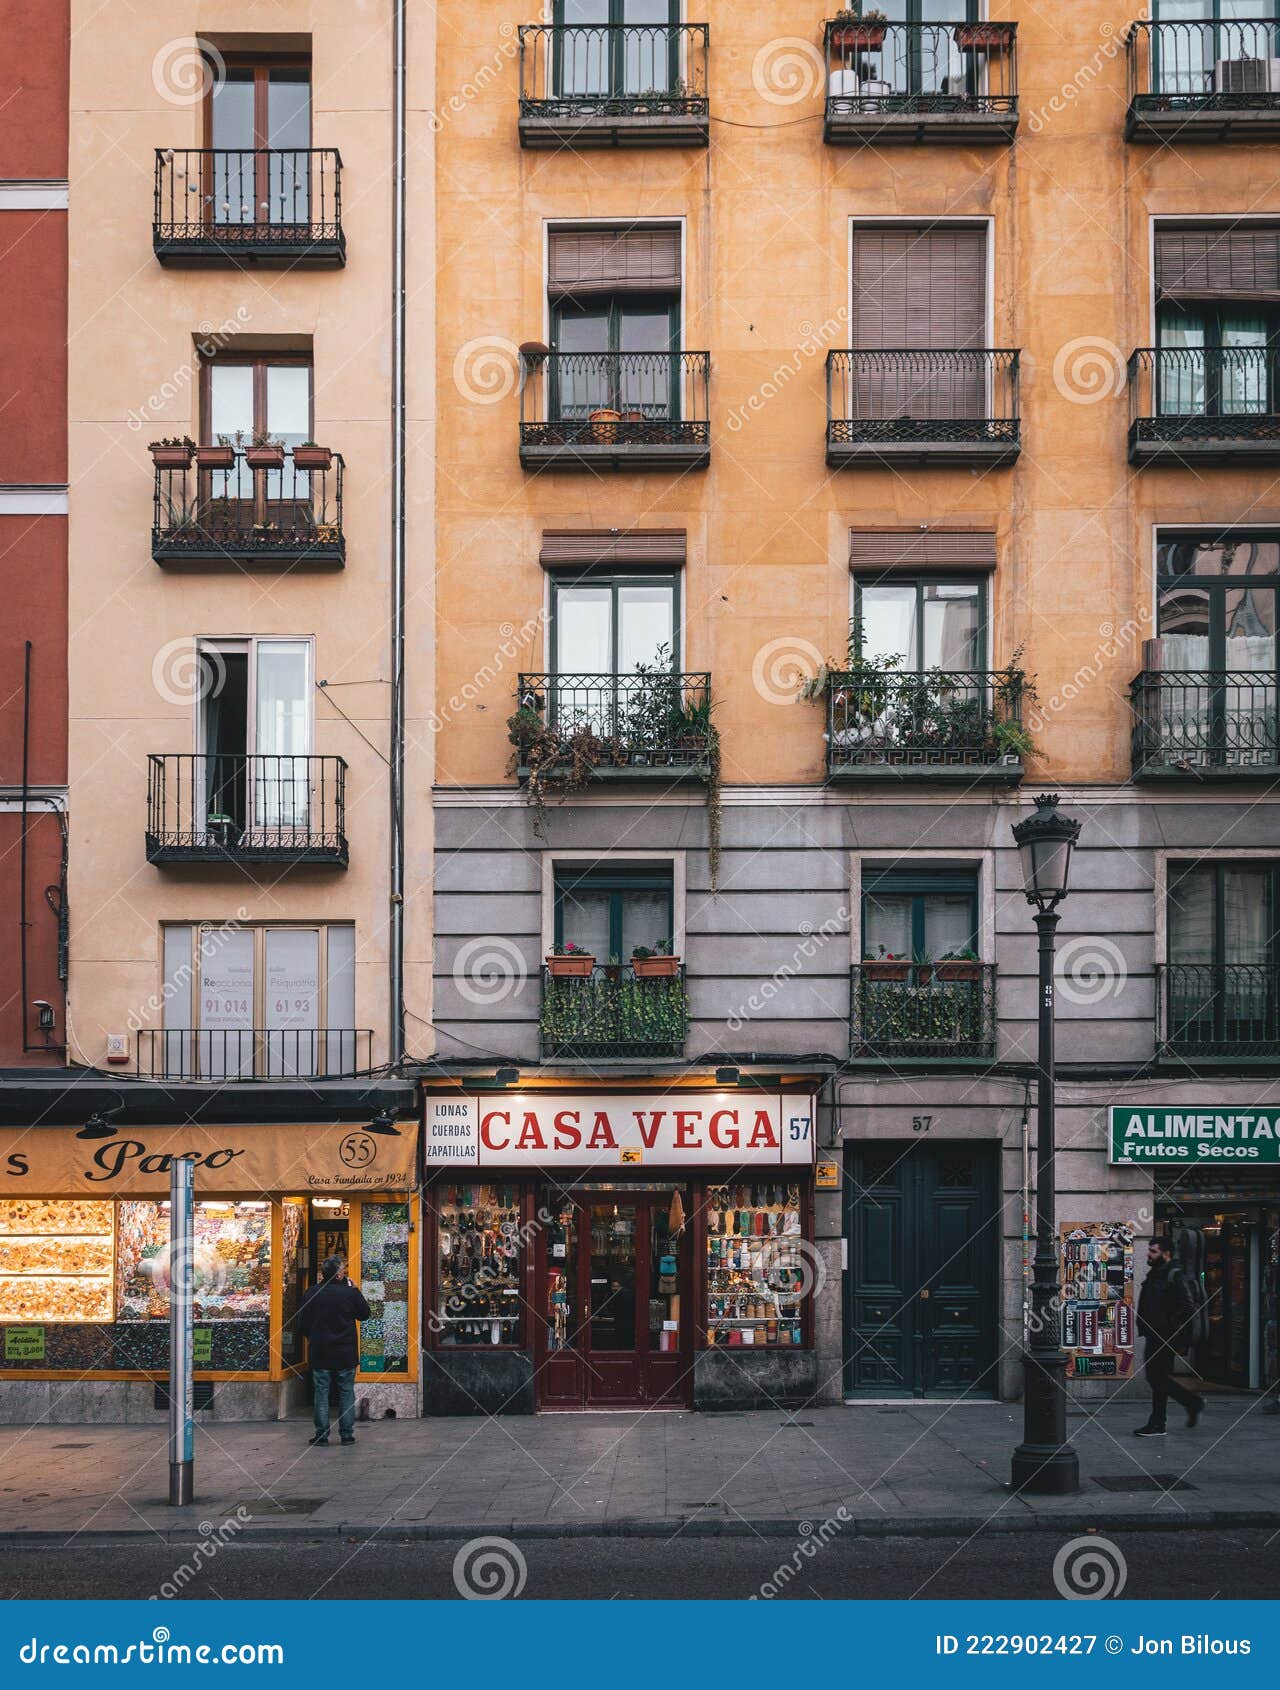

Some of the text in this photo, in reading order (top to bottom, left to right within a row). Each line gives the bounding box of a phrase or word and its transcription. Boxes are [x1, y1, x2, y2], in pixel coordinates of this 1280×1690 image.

[435, 1104, 468, 1117] LONAS
[480, 1110, 780, 1150] CASA VEGA
[789, 1117, 812, 1141] 57
[912, 1115, 932, 1131] 57
[432, 1125, 471, 1137] CUERDAS
[344, 1139, 370, 1161] 55
[427, 1145, 476, 1157] ZAPATILLAS
[1123, 1142, 1260, 1157] Frutos Secos
[308, 1175, 331, 1184] Casa
[334, 1174, 372, 1184] Fundada
[385, 1172, 407, 1183] 1934
[1085, 1311, 1093, 1344] IMPACTU
